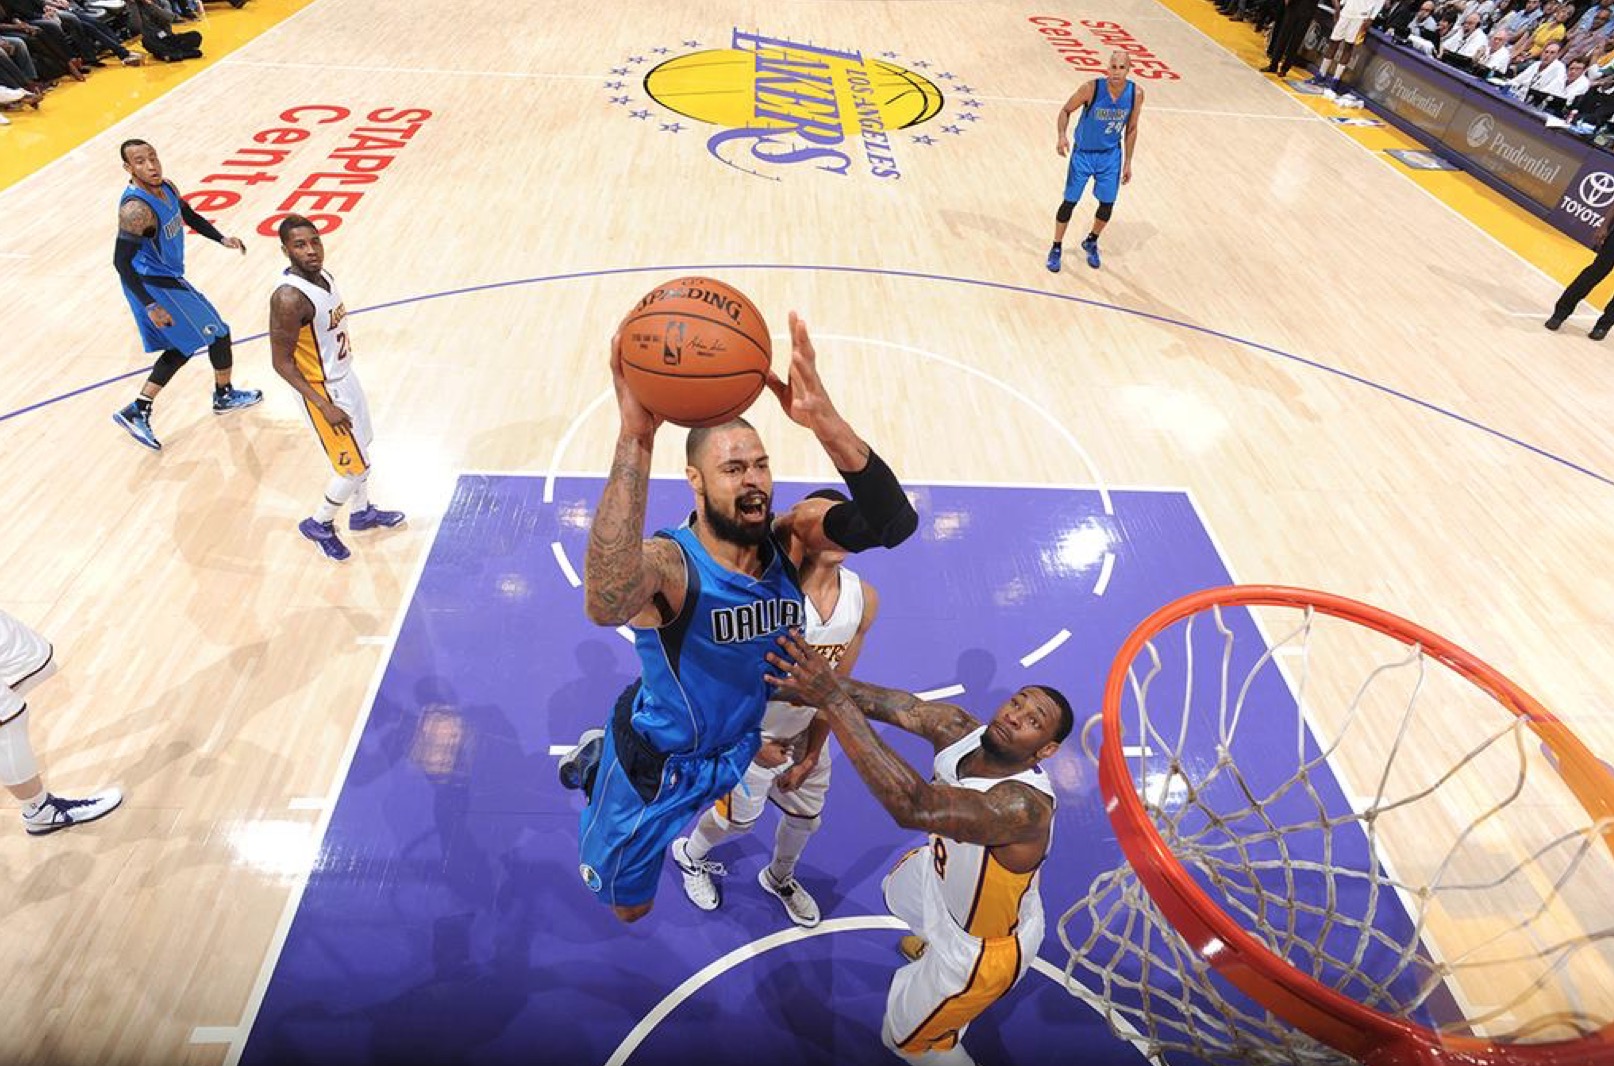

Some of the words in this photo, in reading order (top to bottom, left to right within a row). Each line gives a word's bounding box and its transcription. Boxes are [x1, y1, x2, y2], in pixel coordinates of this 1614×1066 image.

[1028, 16, 1110, 76] Center
[706, 26, 865, 182] LAKERS
[845, 68, 874, 95] LOS
[1390, 77, 1444, 119] Prudential
[853, 94, 901, 180] ANGELES
[1489, 133, 1561, 184] Prudential
[182, 105, 351, 235] Cente
[1560, 195, 1606, 228] TOYOTA
[711, 598, 806, 645] DALLA
